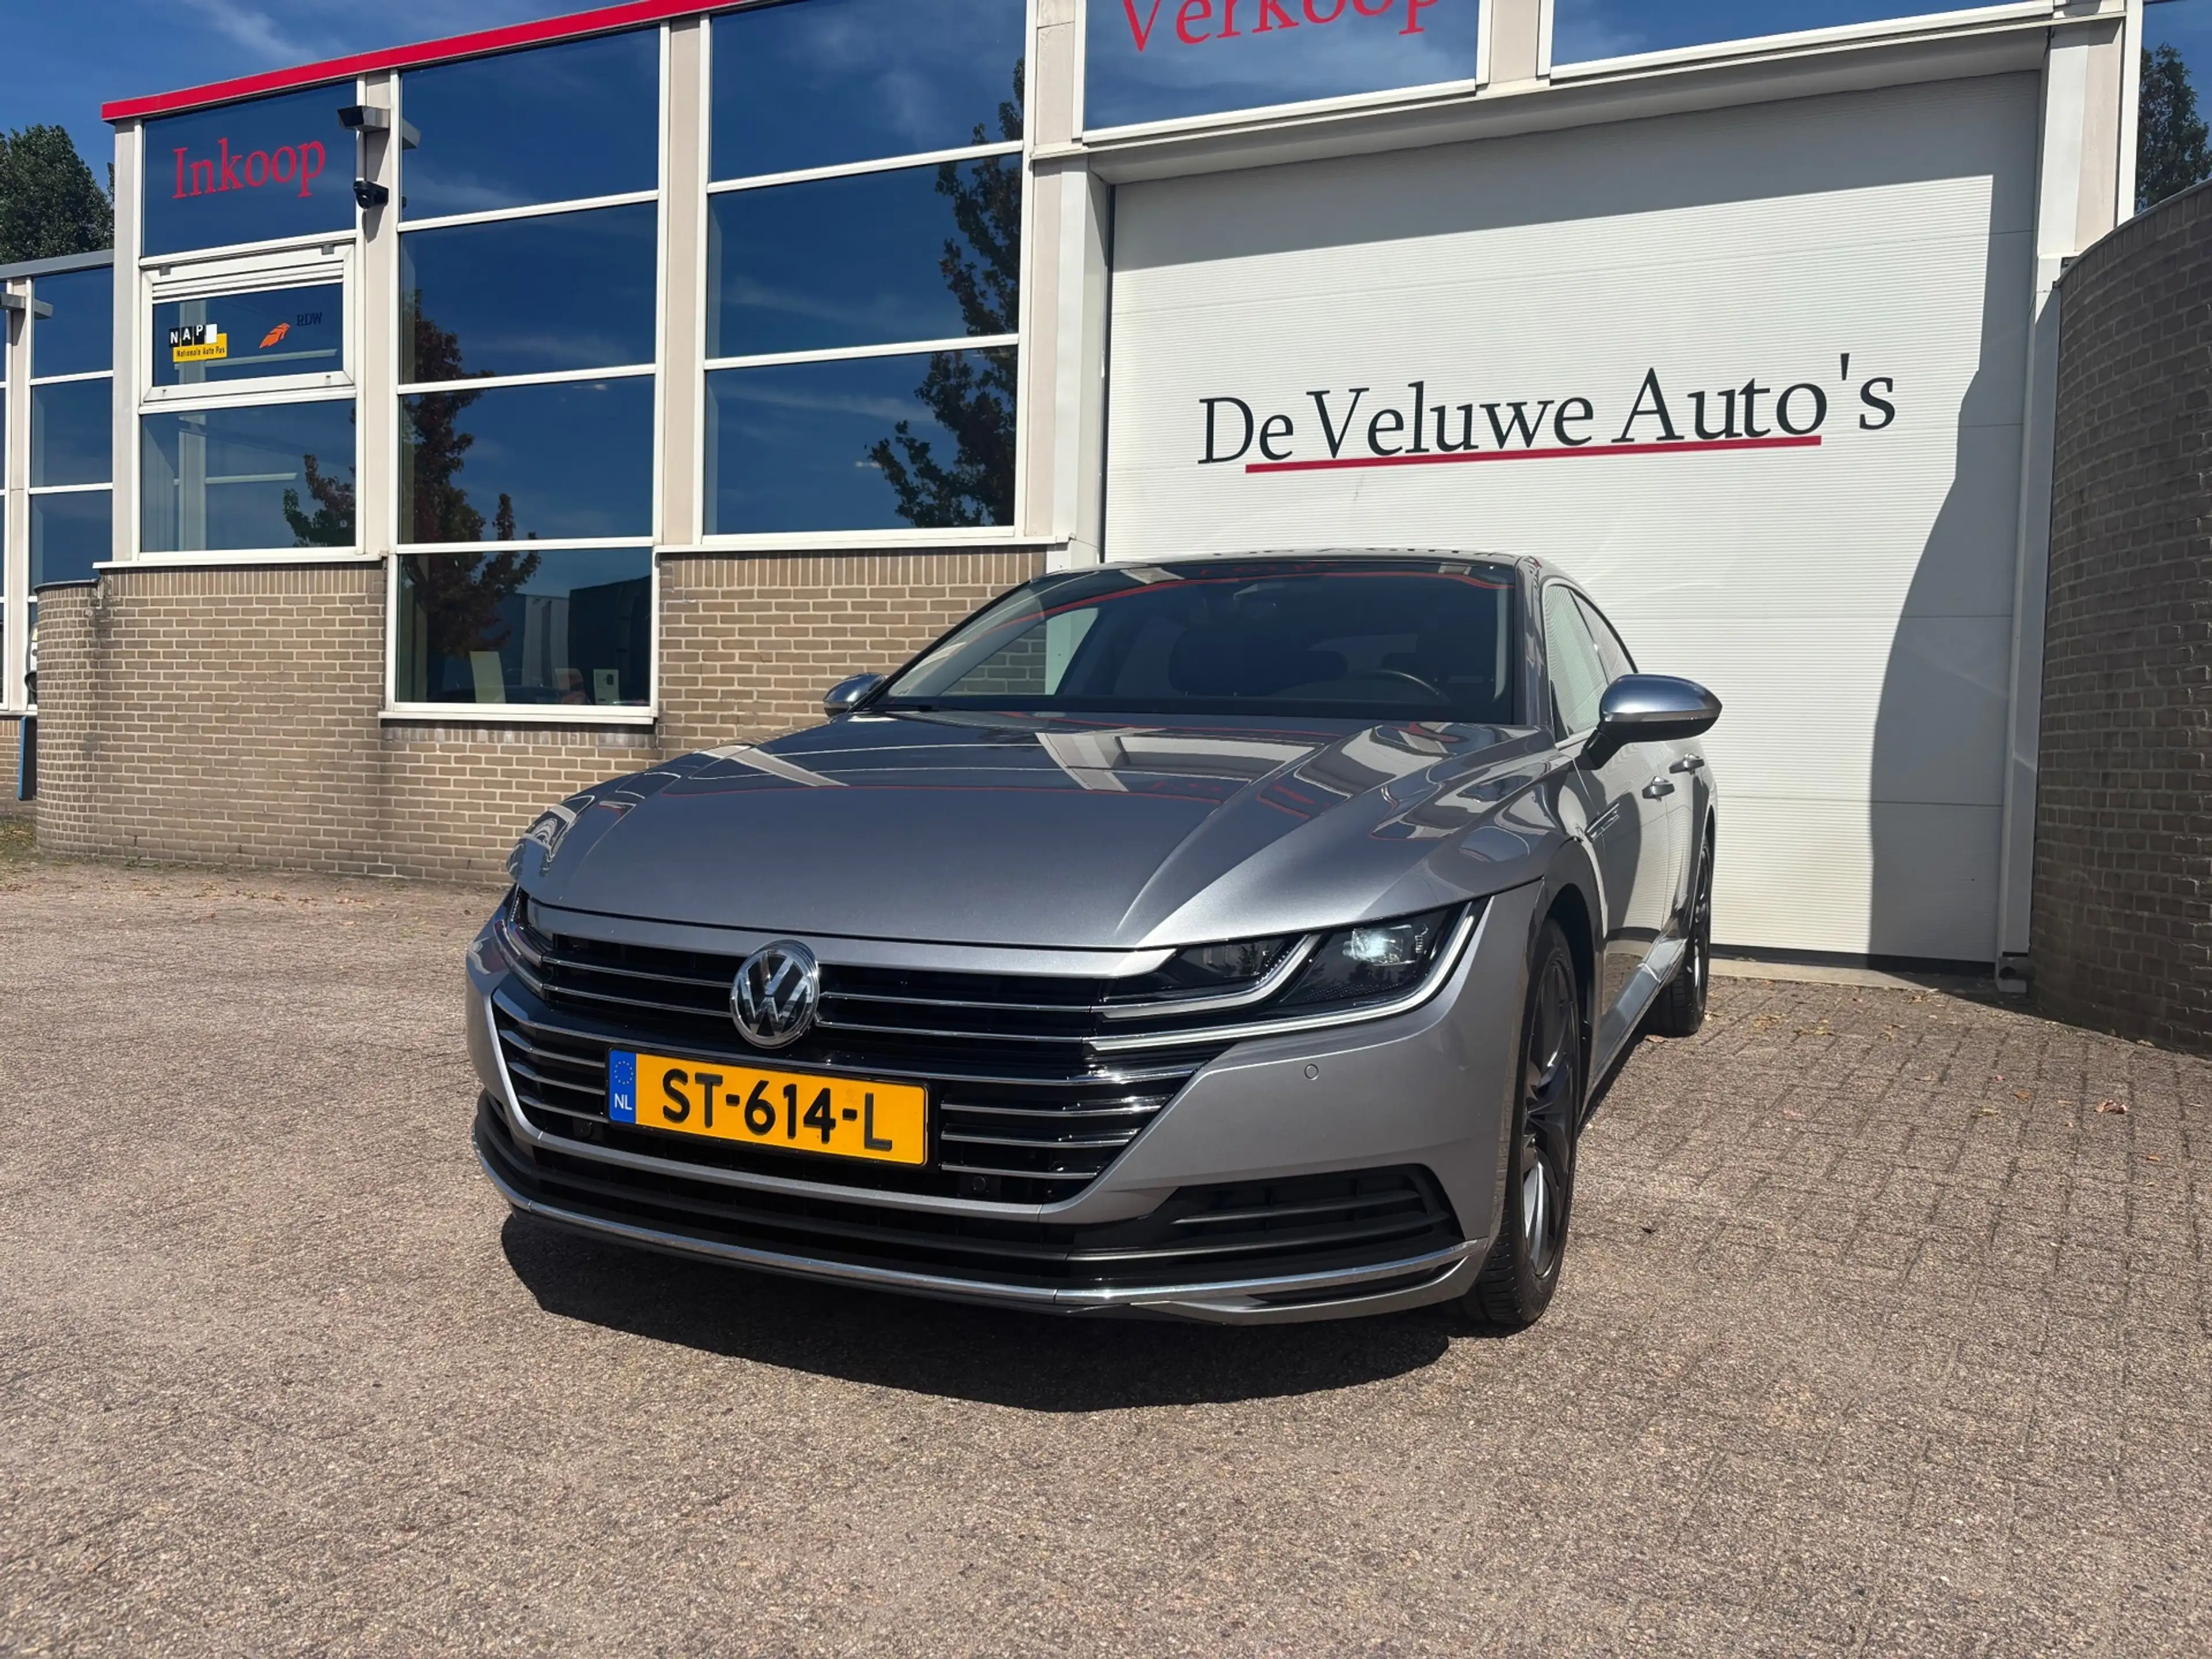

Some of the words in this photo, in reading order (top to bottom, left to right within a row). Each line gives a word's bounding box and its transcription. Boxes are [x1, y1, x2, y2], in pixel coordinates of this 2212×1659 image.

[172, 137, 325, 199] Inkoop
[297, 312, 323, 327] RDW
[169, 324, 204, 344] NAP
[176, 348, 201, 358] Nationale
[203, 346, 214, 355] Auto
[1198, 396, 1294, 464] De
[1306, 381, 1594, 459] Veluwe
[1611, 353, 1896, 443] Auto's
[614, 1093, 632, 1111] NL
[662, 1068, 893, 1152] ST-614-L
